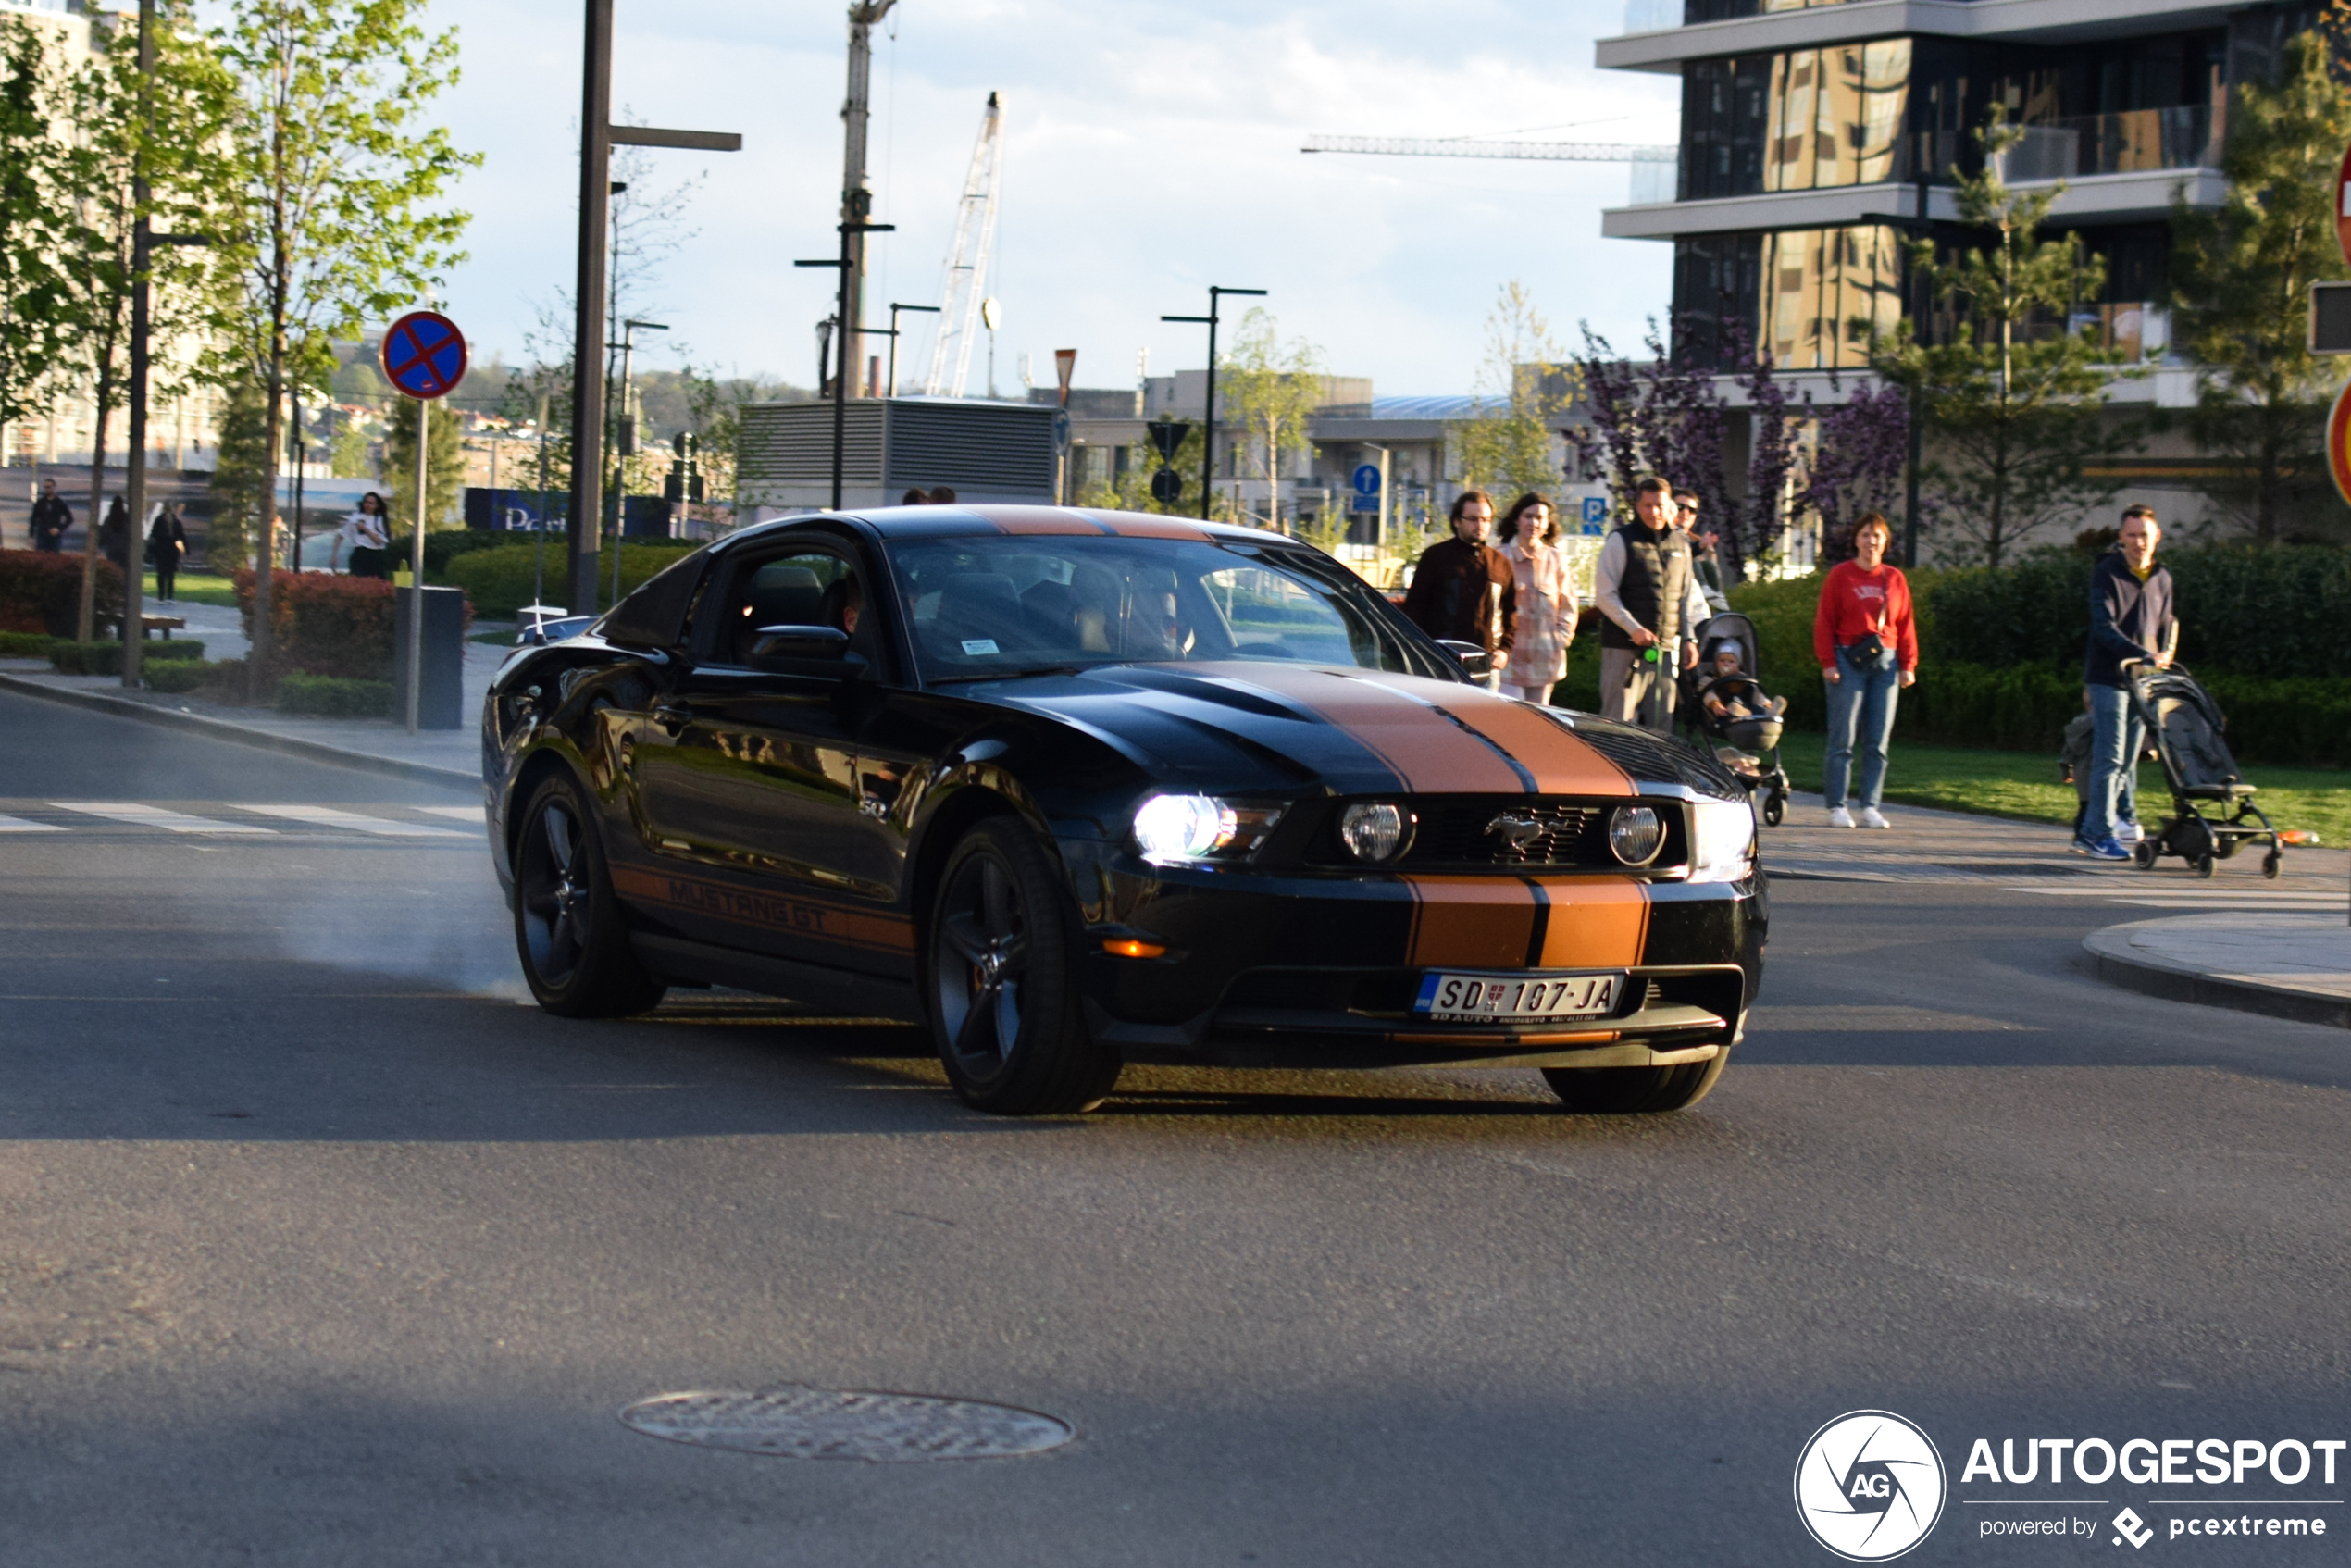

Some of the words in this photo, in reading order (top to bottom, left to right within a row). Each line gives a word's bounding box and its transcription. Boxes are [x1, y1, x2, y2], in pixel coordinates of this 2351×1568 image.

[1586, 500, 1602, 520] P
[669, 879, 788, 924] MUSTANG
[792, 905, 827, 929] GT
[1440, 980, 1482, 1010] SD
[1430, 1013, 1450, 1021] SD
[1451, 1014, 1493, 1023] AUTO
